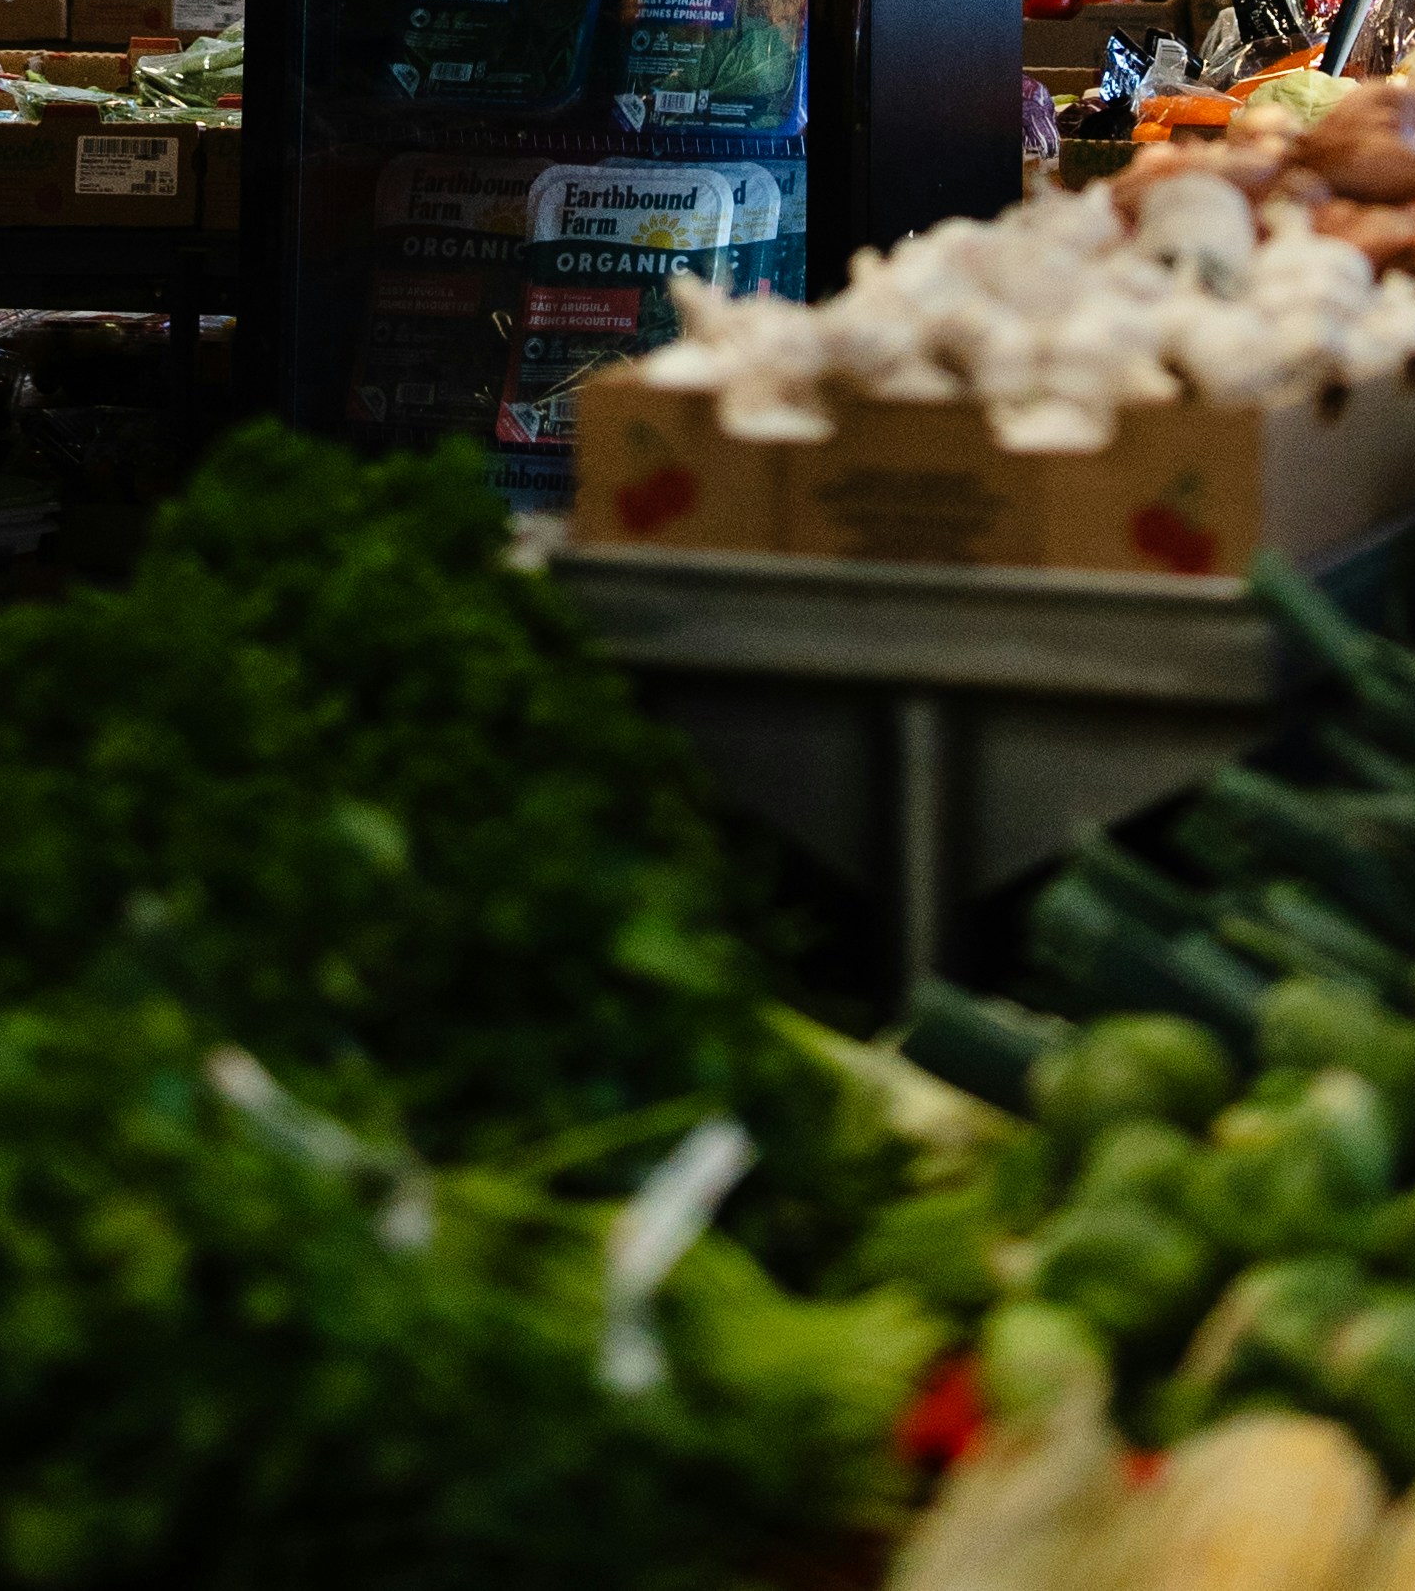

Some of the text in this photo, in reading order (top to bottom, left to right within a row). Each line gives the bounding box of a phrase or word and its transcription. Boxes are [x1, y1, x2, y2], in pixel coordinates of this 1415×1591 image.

[634, 6, 725, 22] JEUNES ÉPINARDS
[408, 195, 462, 221] Farm
[563, 182, 698, 211] Earthbound
[560, 209, 620, 237] Farm
[402, 236, 526, 261] ORGANIC
[556, 252, 690, 277] ORGANIC
[560, 302, 610, 313] ARUGULA
[569, 316, 632, 328] ROQUETTES
